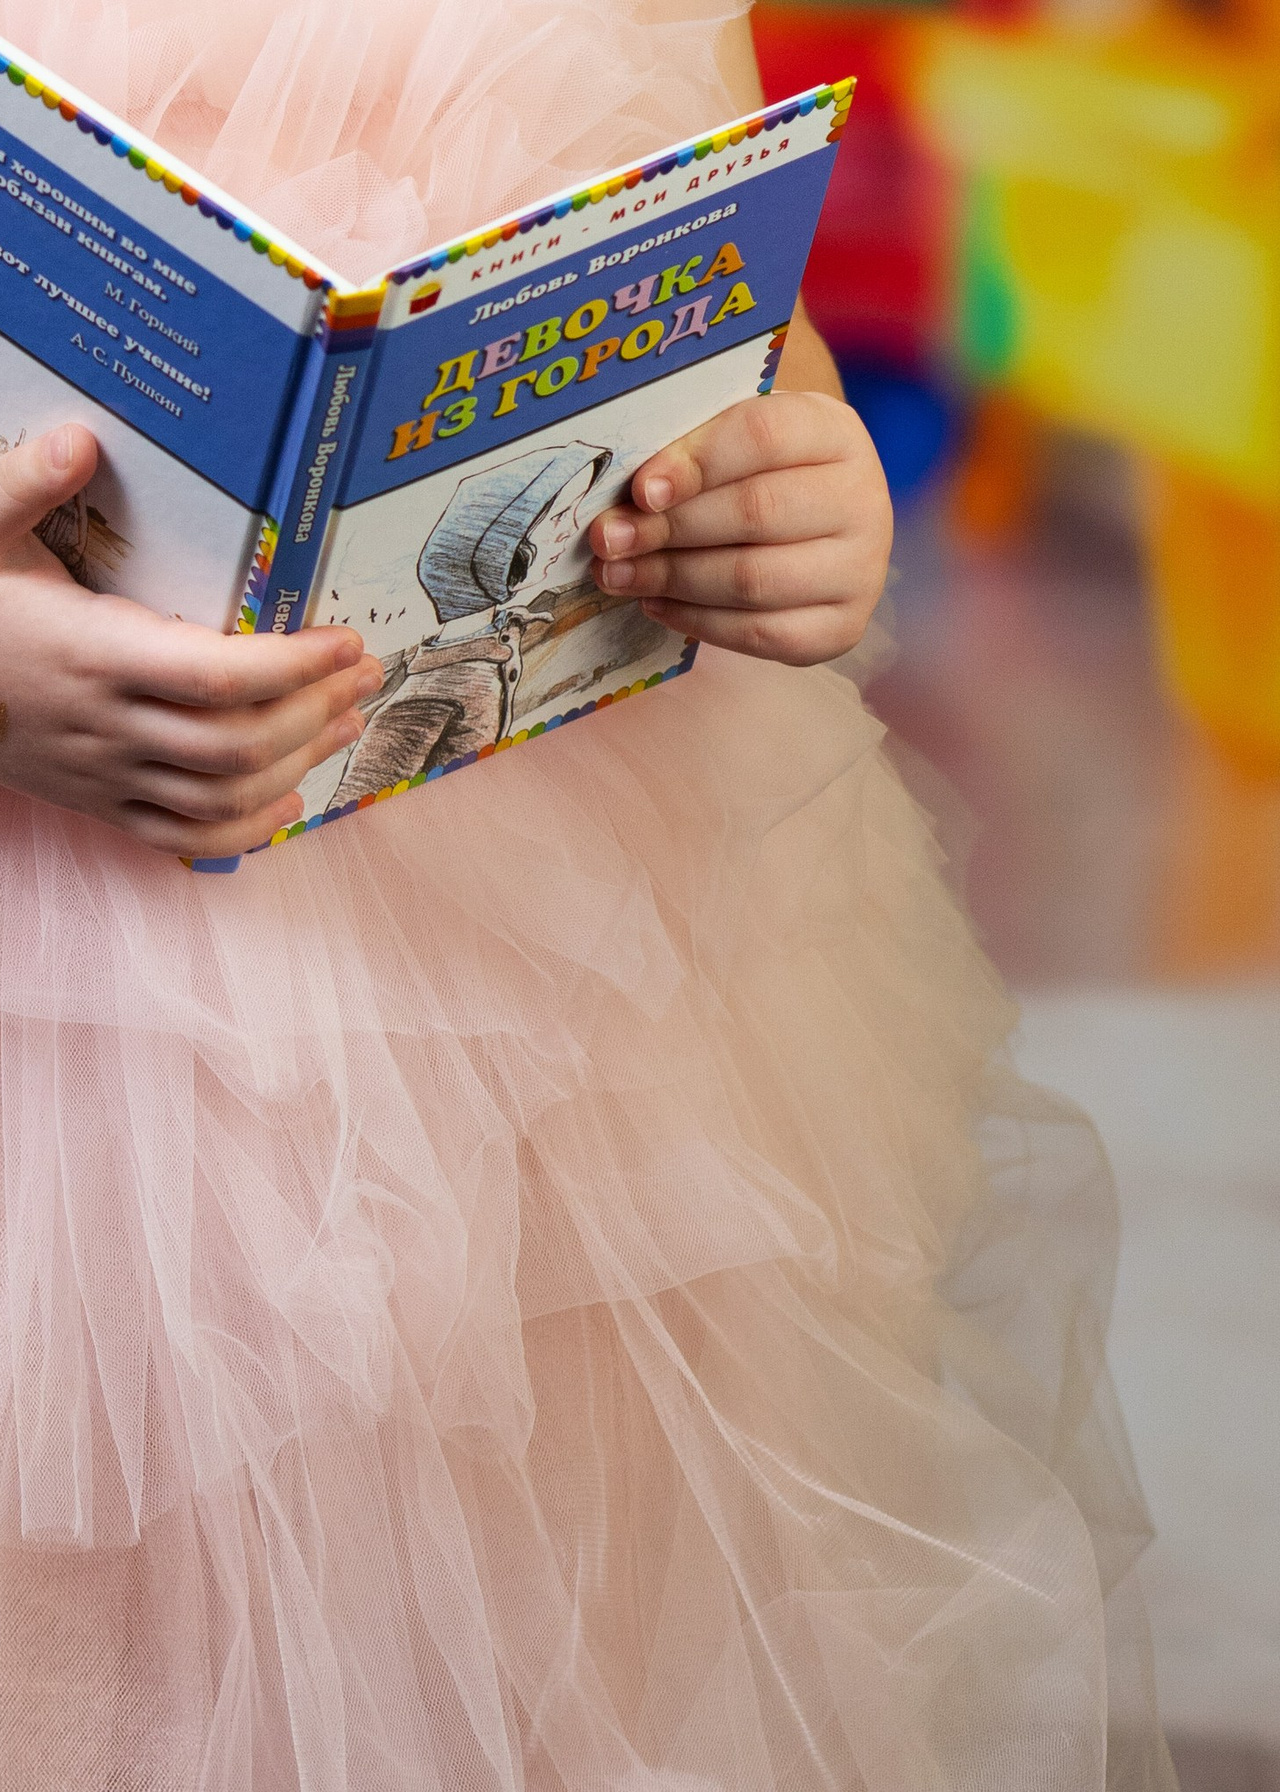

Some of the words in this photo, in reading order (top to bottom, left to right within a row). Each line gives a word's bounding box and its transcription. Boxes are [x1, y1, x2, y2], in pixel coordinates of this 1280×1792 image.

[11, 162, 115, 240] хорошим
[121, 238, 147, 261] во
[153, 258, 197, 296] мне
[77, 231, 167, 302] книгам.
[469, 270, 579, 325] Любовь
[586, 202, 738, 276] Воронкова
[471, 234, 561, 281] КНИГИ
[609, 190, 667, 222] МОИ
[686, 138, 790, 192] ДРУЗЬЯ
[34, 273, 119, 338] лучшее
[123, 334, 211, 402] учение!
[71, 332, 88, 352] А.
[93, 345, 107, 366] С.
[112, 361, 183, 418] Пушкин
[104, 282, 125, 305] М.
[129, 300, 201, 357] Горький
[386, 395, 479, 461] ИЗ
[493, 281, 757, 418] ГОРОДА
[423, 242, 746, 409] ДЕВОЧКА
[322, 364, 357, 438] Любовь
[294, 441, 337, 543] Воронкова
